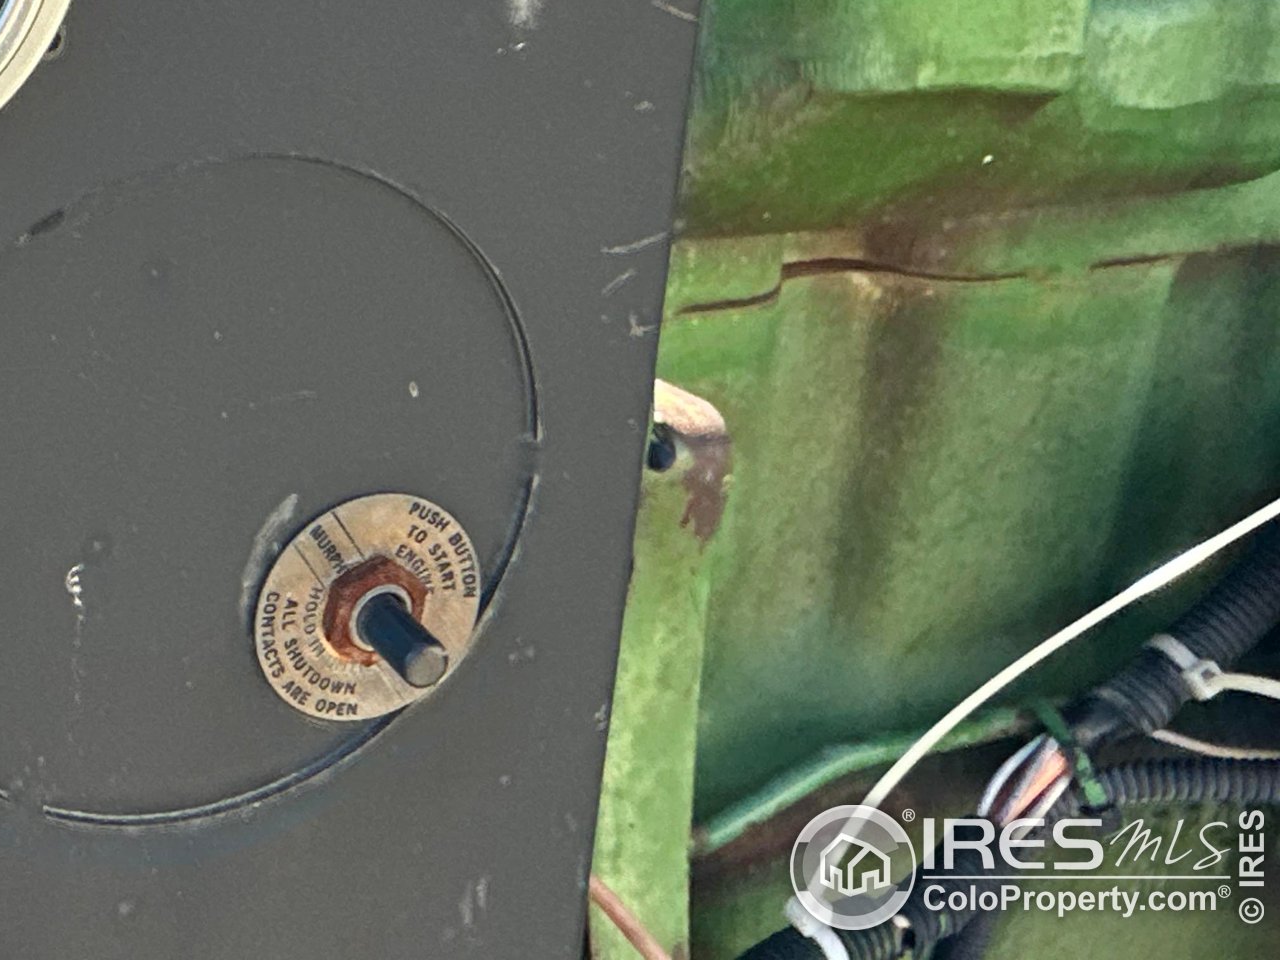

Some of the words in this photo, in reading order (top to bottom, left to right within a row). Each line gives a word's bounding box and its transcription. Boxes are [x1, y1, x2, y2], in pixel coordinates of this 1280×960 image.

[407, 524, 428, 544] TO
[428, 543, 456, 591] START
[408, 502, 450, 532] PUSH
[448, 532, 477, 598] BUTTON
[282, 598, 299, 630] ALL
[261, 591, 286, 678] CONTACTS
[282, 681, 312, 706] ARE
[315, 699, 358, 716] OPEN
[284, 638, 357, 695] SHUTDOWN
